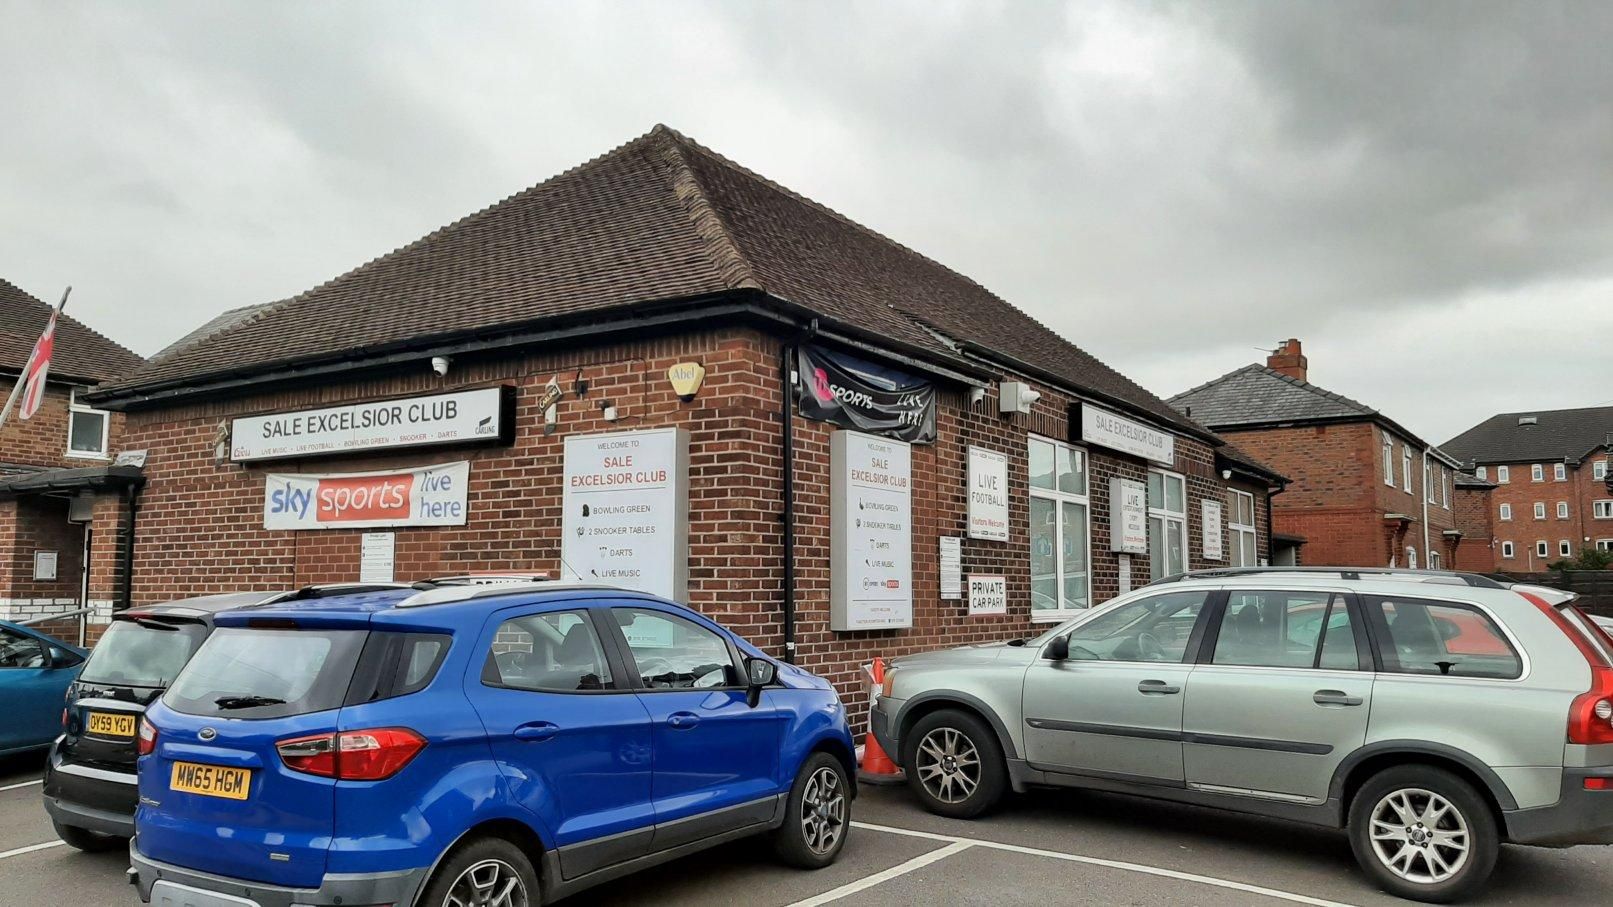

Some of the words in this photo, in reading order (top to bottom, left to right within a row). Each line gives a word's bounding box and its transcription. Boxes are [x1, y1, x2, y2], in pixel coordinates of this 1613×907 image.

[672, 368, 694, 380] Abel
[830, 384, 872, 409] SPORTS
[263, 418, 302, 438] SALE
[308, 406, 402, 434] EXCELSIOR
[408, 400, 458, 423] CLUB
[1096, 415, 1112, 433] SALE
[1114, 421, 1147, 443] EXCELSIOR
[598, 441, 628, 450] WELCOME
[604, 456, 632, 468] SALE
[872, 458, 888, 469] SALE
[420, 472, 452, 492] live
[571, 473, 632, 486] EXCELSIOR
[636, 470, 666, 483] CLUB
[852, 469, 888, 486] EXCELSIOR
[890, 476, 907, 488] CLUB
[978, 473, 998, 490] LIVE
[271, 482, 312, 520] sky
[321, 481, 406, 518] sports
[972, 492, 1004, 507] FOOTBALL
[1128, 494, 1138, 506] LIVE
[420, 497, 461, 518] here
[593, 506, 625, 514] BOWLING
[626, 505, 651, 514] GREEN
[594, 527, 627, 535] SNOOKER
[618, 569, 640, 577] MUSIC
[972, 582, 1003, 595] PRIVATE
[972, 598, 986, 608] CAR
[987, 597, 1004, 608] PARK
[114, 717, 133, 733] YGV
[176, 764, 212, 790] MW65
[214, 769, 244, 794] HGM
